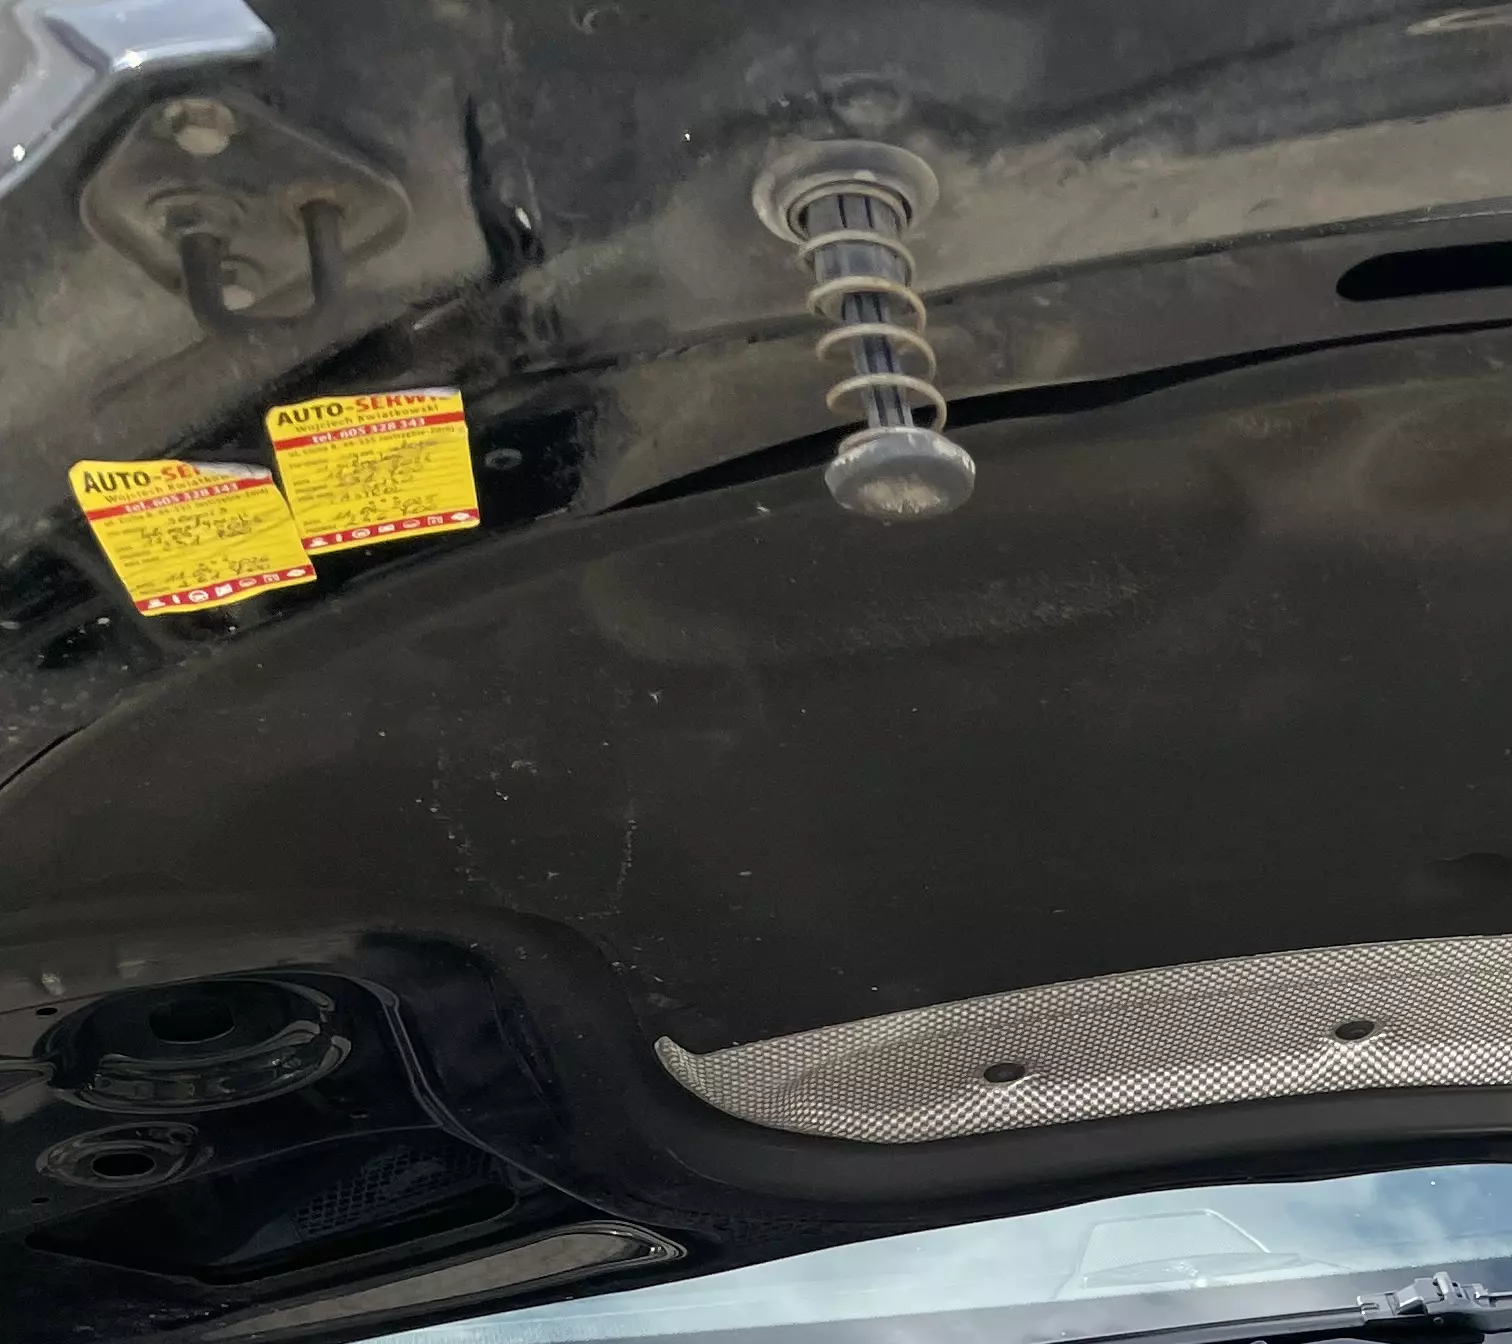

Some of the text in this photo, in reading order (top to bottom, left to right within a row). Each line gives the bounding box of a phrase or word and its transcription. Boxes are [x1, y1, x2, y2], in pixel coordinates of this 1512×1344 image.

[296, 404, 440, 435] Wojciech Kwiatkowski
[311, 432, 335, 445] tel.
[401, 416, 426, 431] 343
[104, 485, 165, 504] Wojciech
[124, 499, 148, 514] tel.
[153, 494, 179, 509] 605
[212, 482, 239, 497] 343
